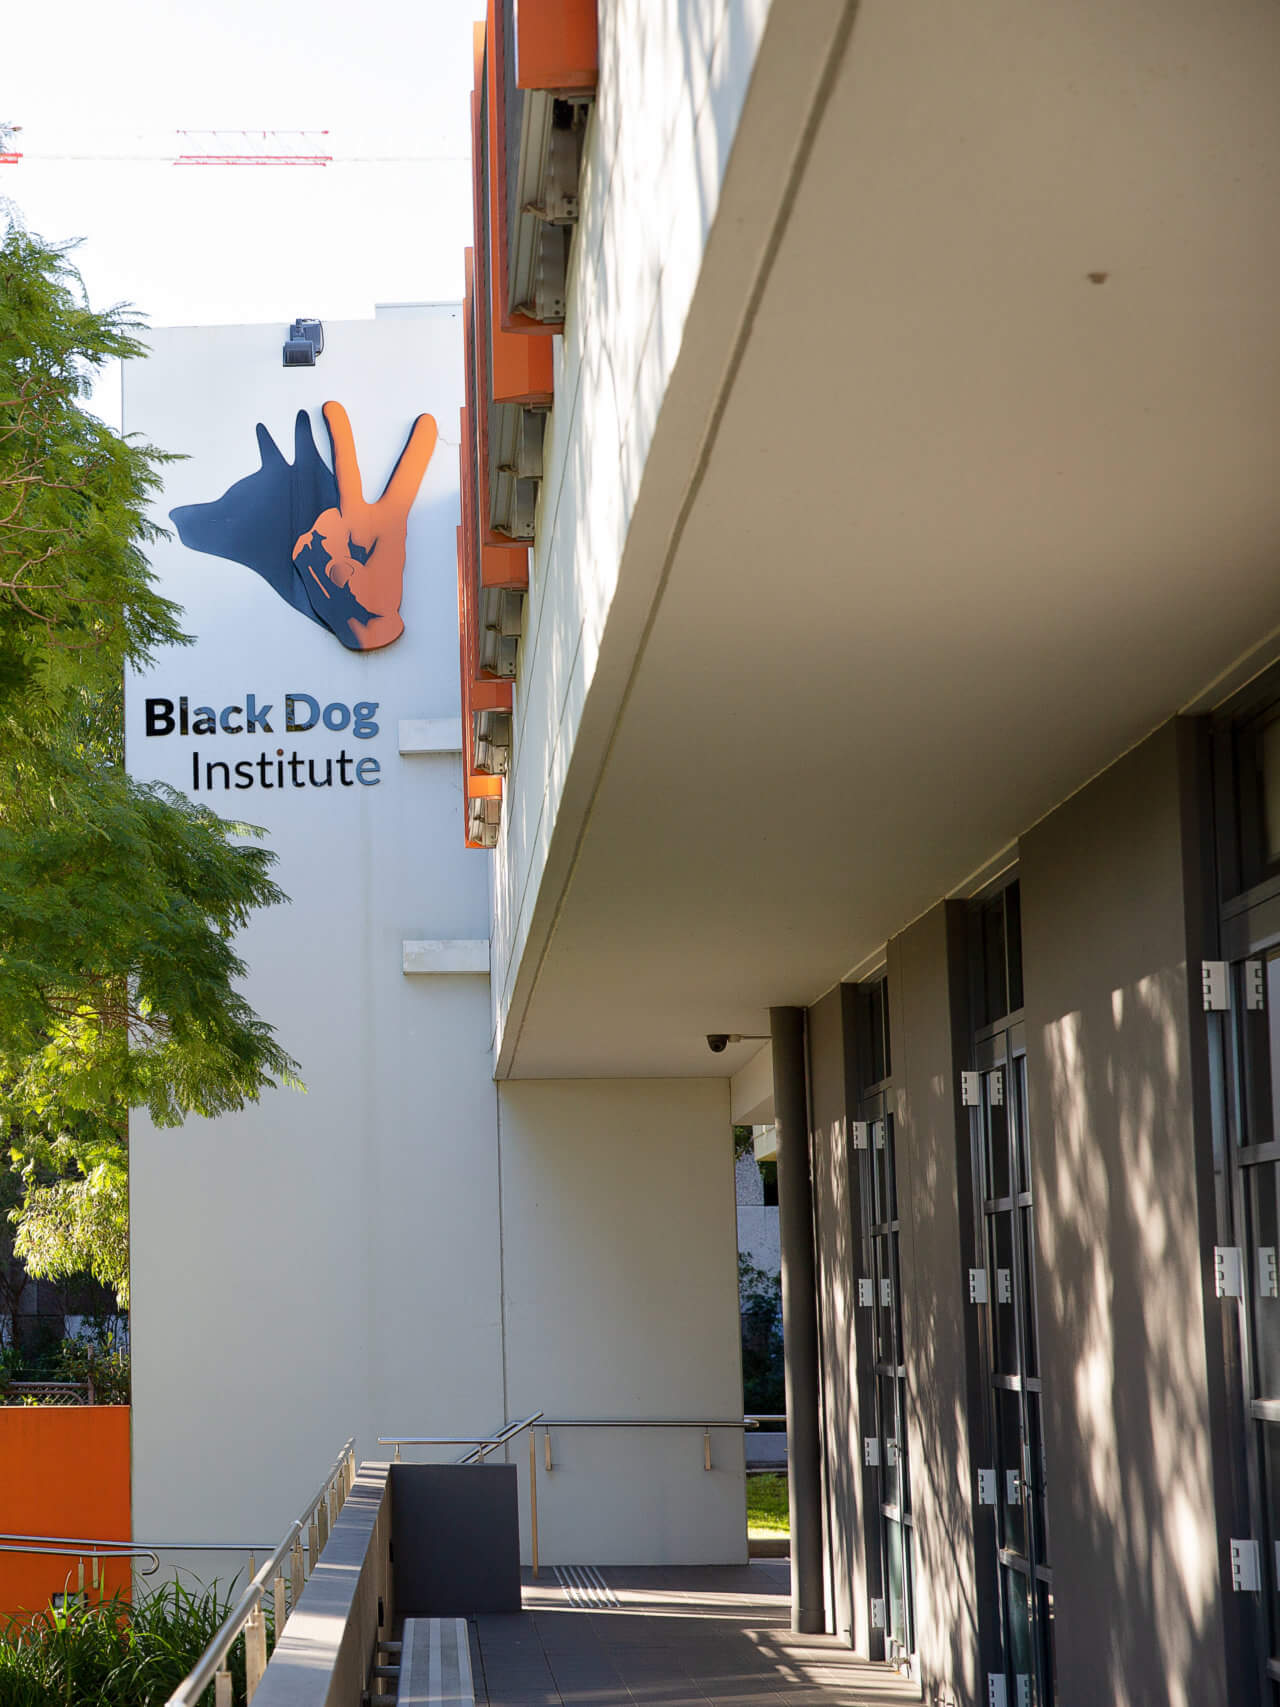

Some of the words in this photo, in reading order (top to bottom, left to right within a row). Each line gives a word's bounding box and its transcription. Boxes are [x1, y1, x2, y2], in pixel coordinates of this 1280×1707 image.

[145, 693, 274, 737] Black
[284, 692, 380, 740] Dog
[192, 748, 382, 791] Institute
